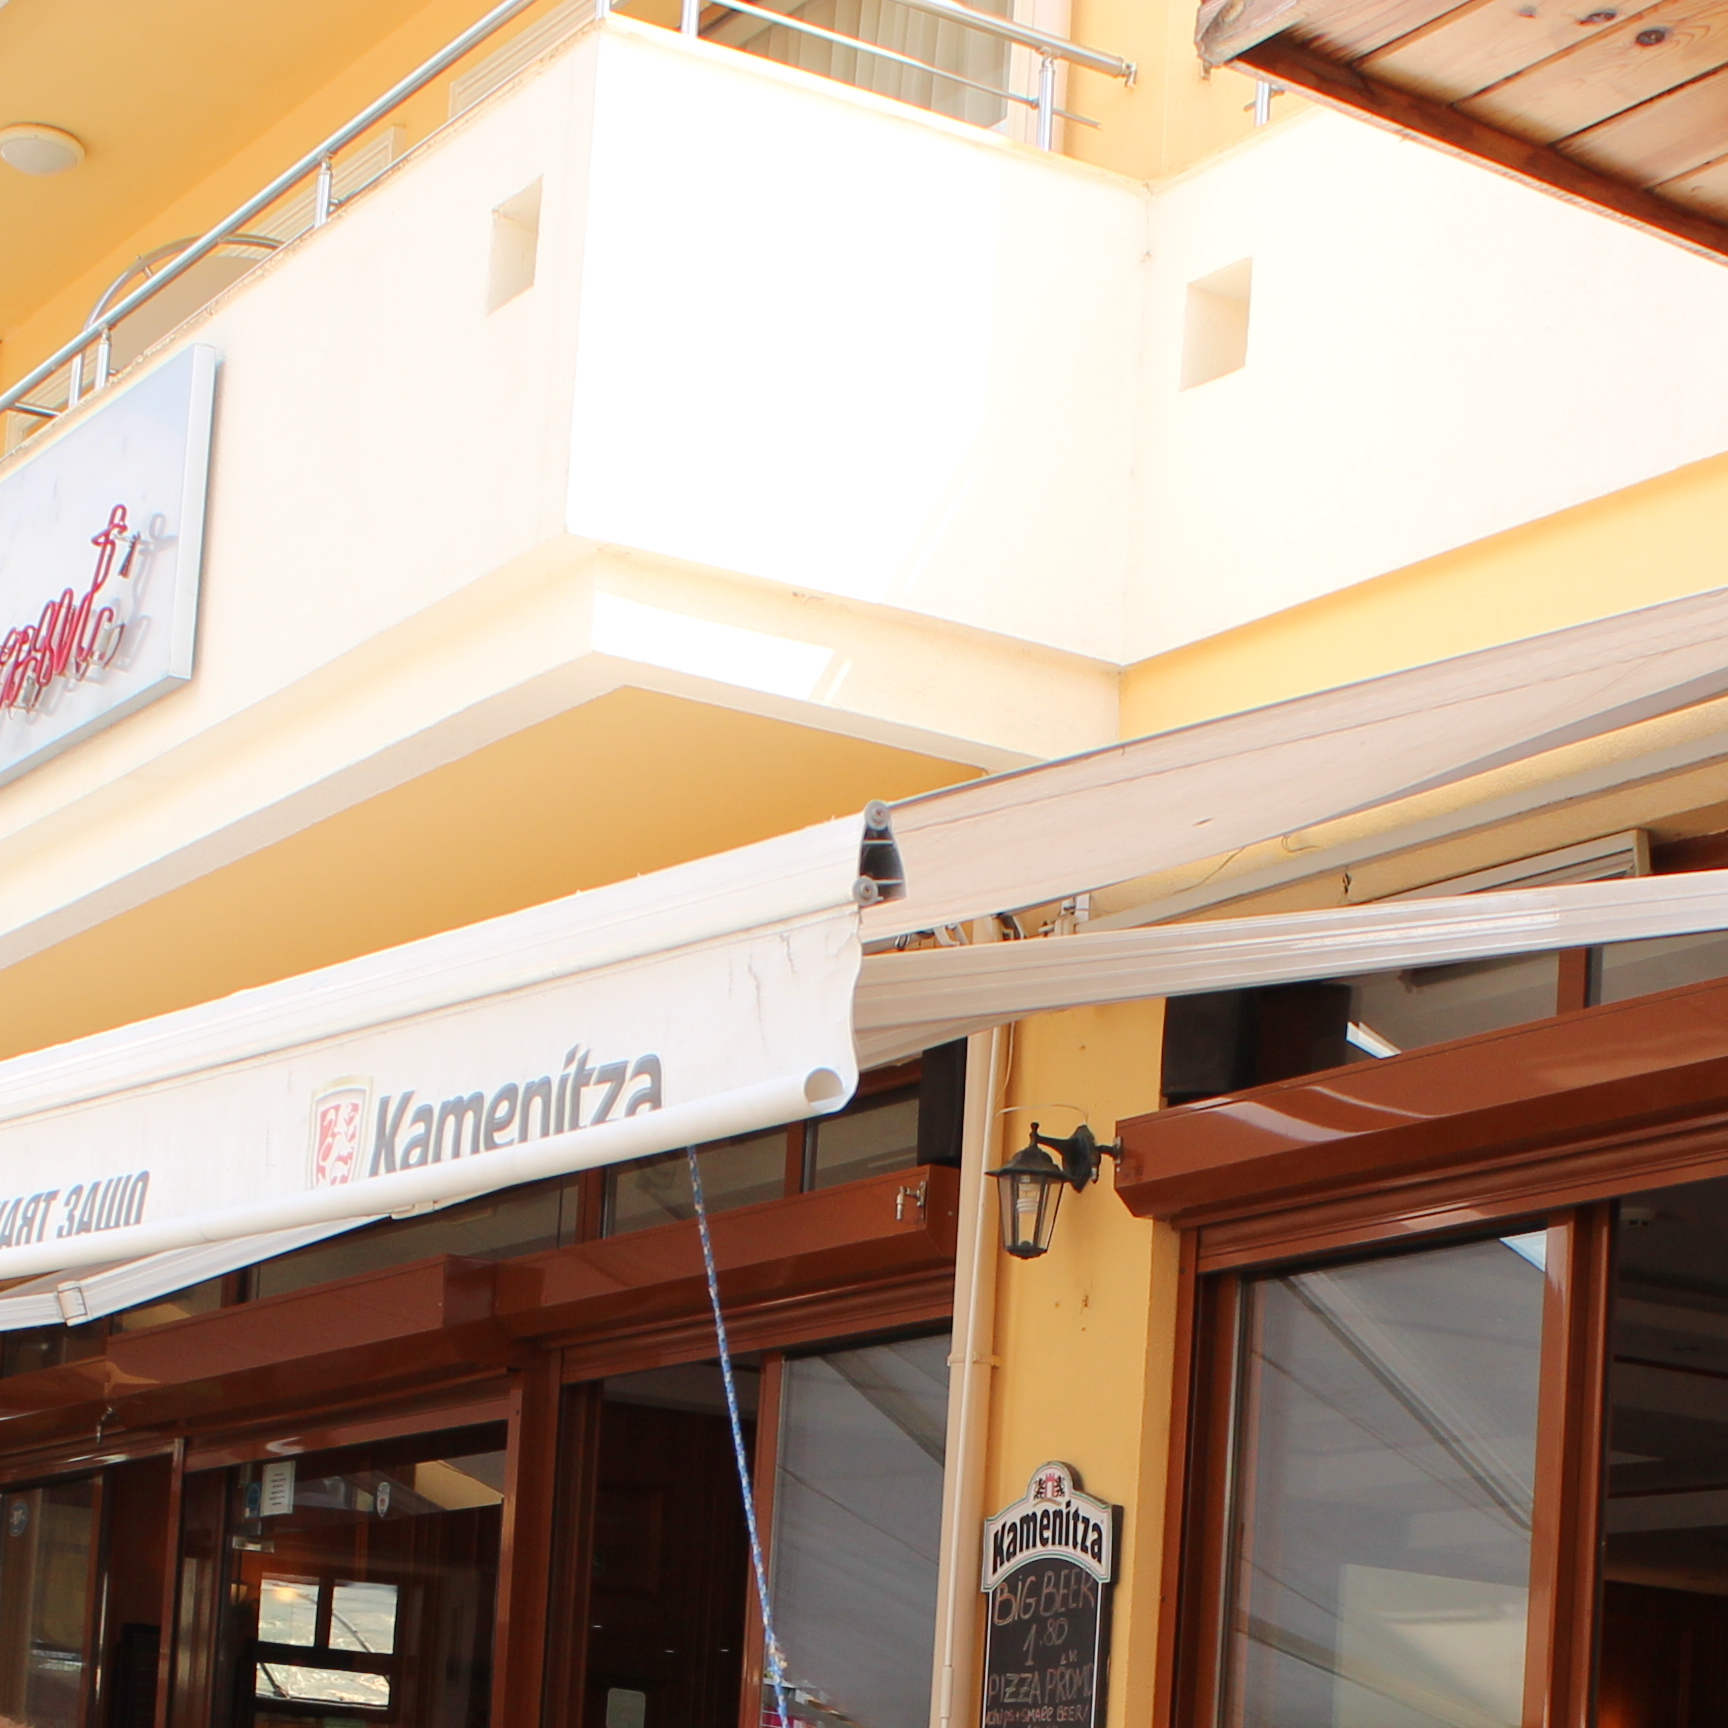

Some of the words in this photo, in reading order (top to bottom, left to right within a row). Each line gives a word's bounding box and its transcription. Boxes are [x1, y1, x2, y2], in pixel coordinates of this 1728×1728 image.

[370, 1043, 665, 1178] Kamenitza
[993, 1500, 1102, 1574] Kamenitza
[1040, 1569, 1095, 1616] BEER
[987, 1670, 1041, 1706] PIZZA
